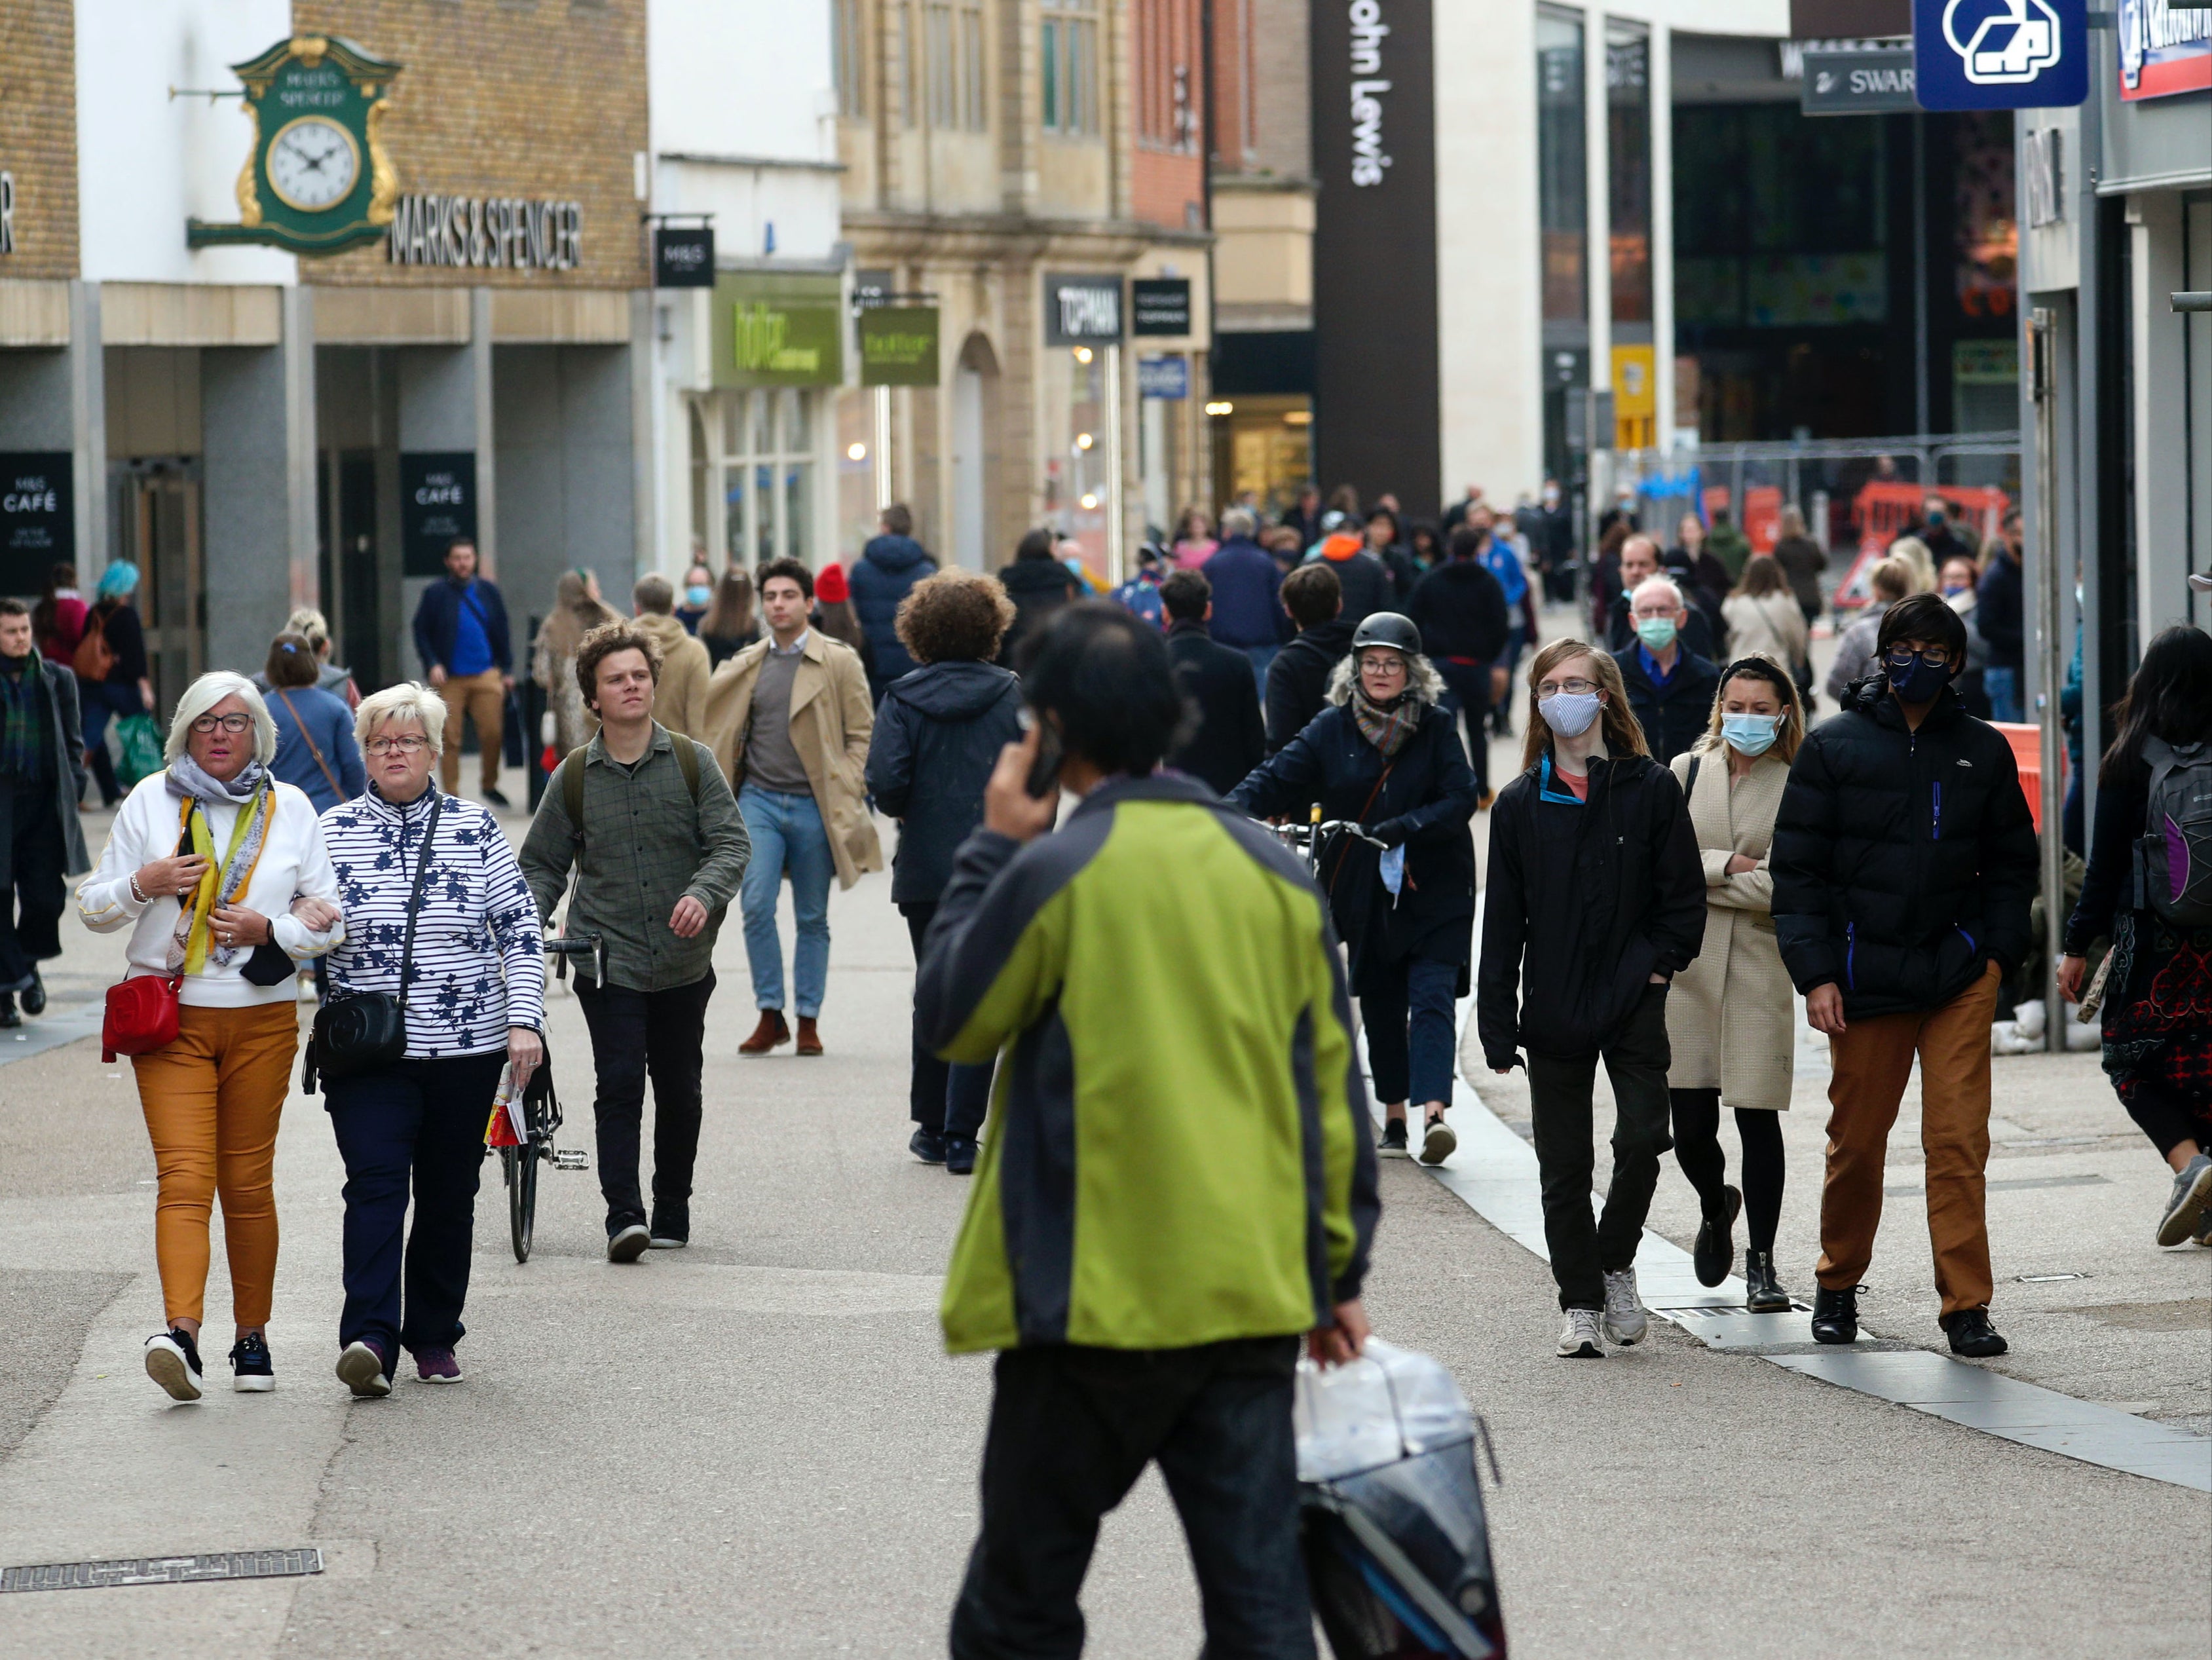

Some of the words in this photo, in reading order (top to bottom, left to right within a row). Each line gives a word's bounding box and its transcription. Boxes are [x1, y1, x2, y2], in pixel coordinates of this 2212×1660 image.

[1349, 0, 1391, 74] ohn
[1351, 79, 1393, 187] Lewis
[3, 488, 57, 512] CAFÉ
[415, 483, 462, 505] CAFÉ
